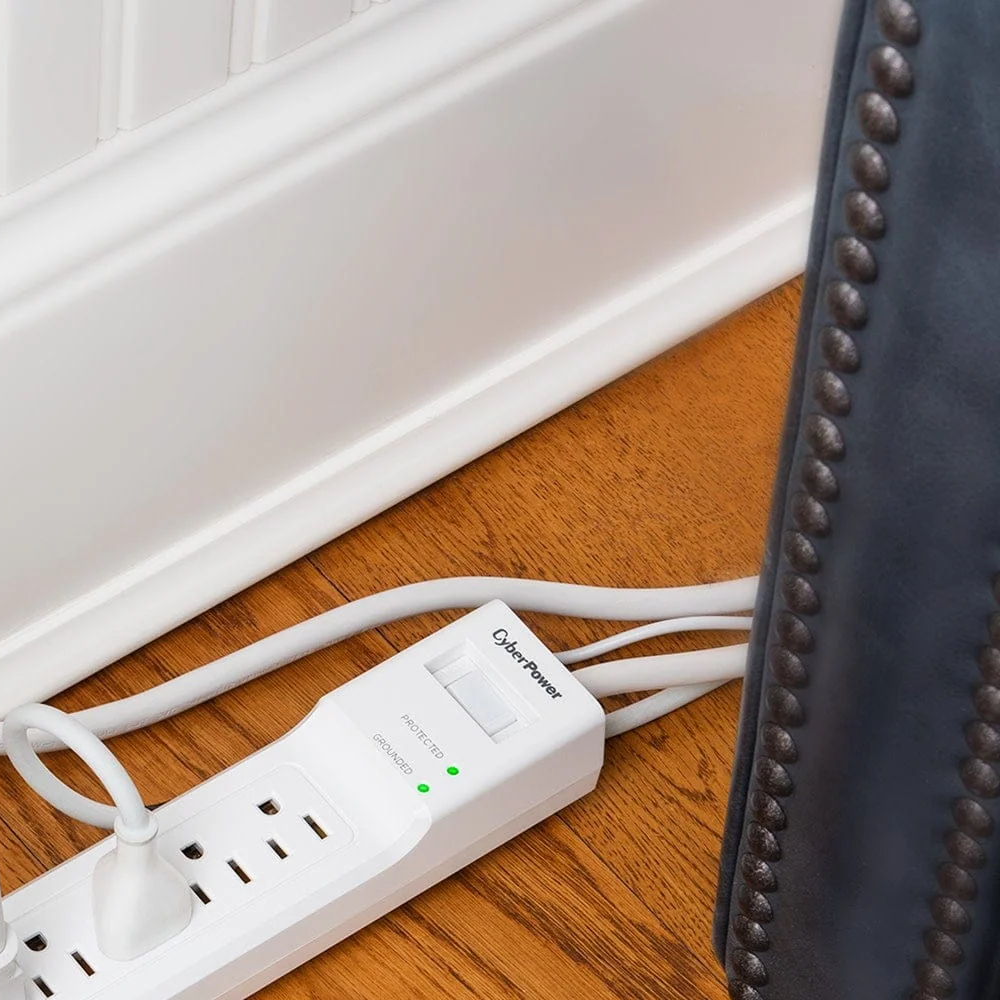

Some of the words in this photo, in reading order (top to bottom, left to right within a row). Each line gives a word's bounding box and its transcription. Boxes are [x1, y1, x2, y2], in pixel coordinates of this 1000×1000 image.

[492, 628, 562, 700] CyberPower
[373, 733, 413, 776] GROUNDED
[400, 714, 444, 760] PROTECTED
